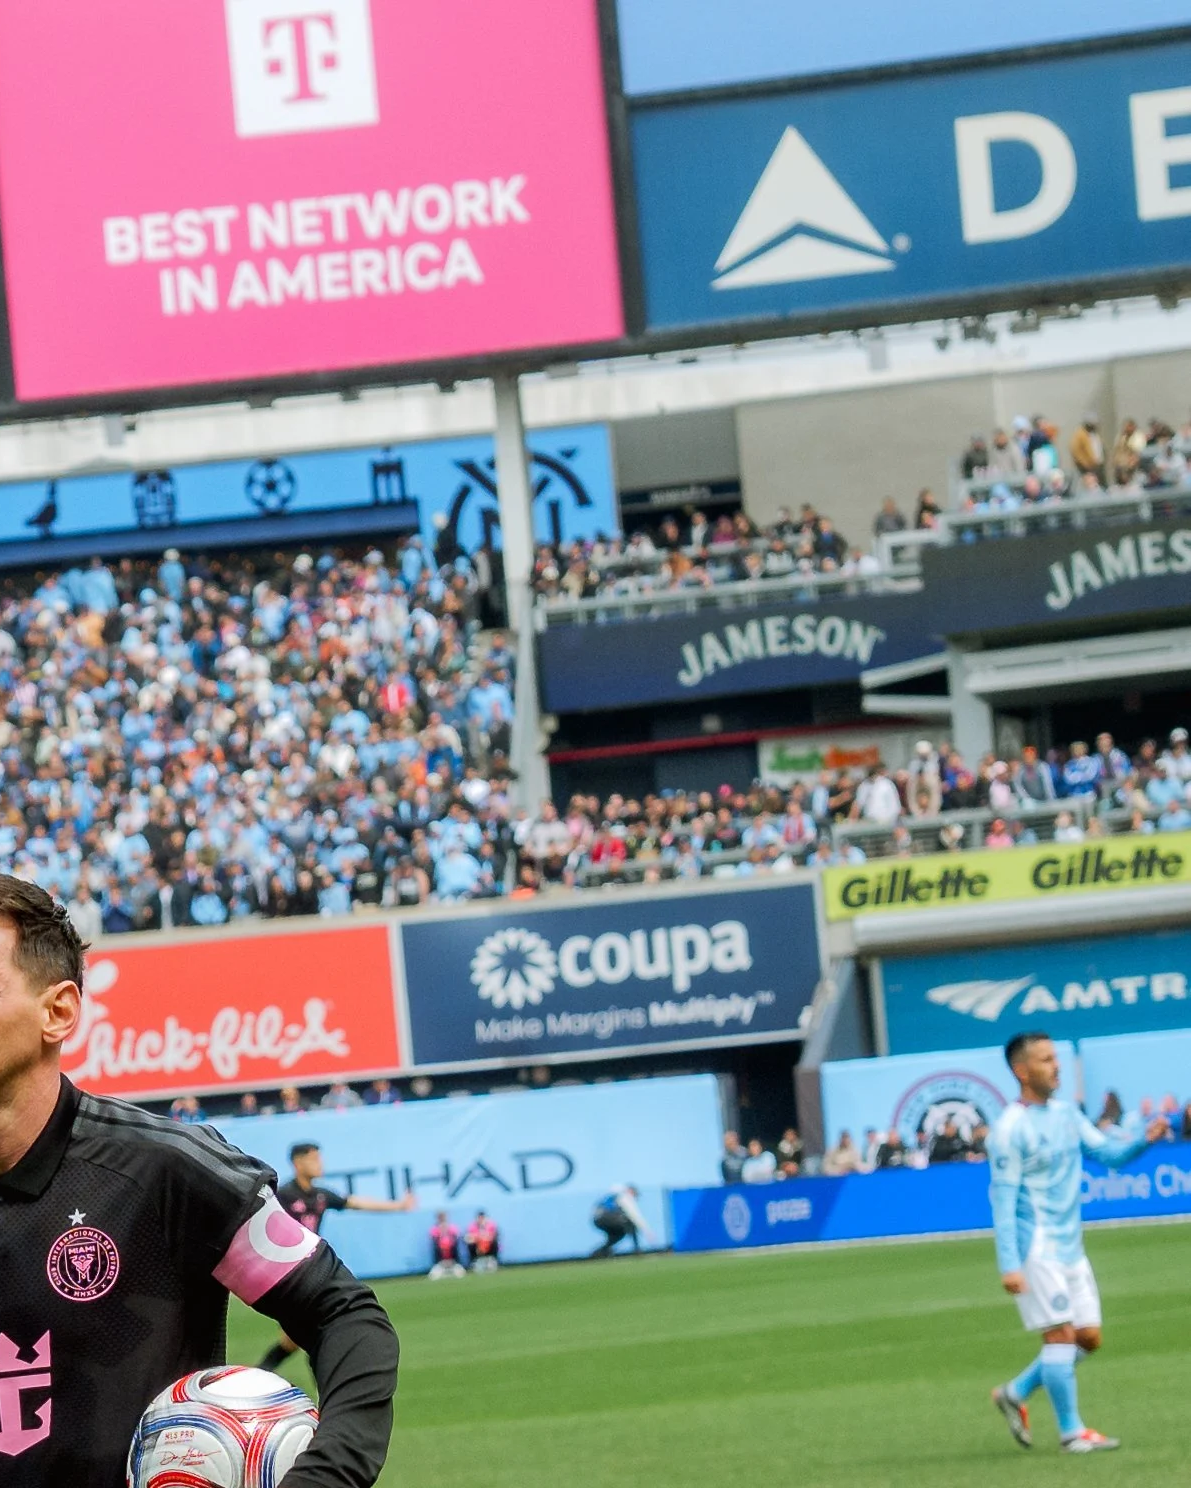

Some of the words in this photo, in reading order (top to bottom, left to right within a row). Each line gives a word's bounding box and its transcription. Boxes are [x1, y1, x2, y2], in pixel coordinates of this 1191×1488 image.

[103, 206, 238, 265] BEST
[248, 175, 530, 251] NETWORK
[160, 265, 218, 316] IN
[228, 240, 484, 310] AMERICA
[677, 613, 875, 687] JAMESON
[841, 868, 990, 908] Gillette
[1032, 847, 1183, 890] Gillette
[559, 920, 753, 993] coupa
[475, 1015, 544, 1044] Make
[546, 1005, 647, 1040] Margins
[322, 1147, 576, 1201] TIHAD
[69, 1245, 96, 1255] MIAMI
[73, 1289, 97, 1298] MMXX
